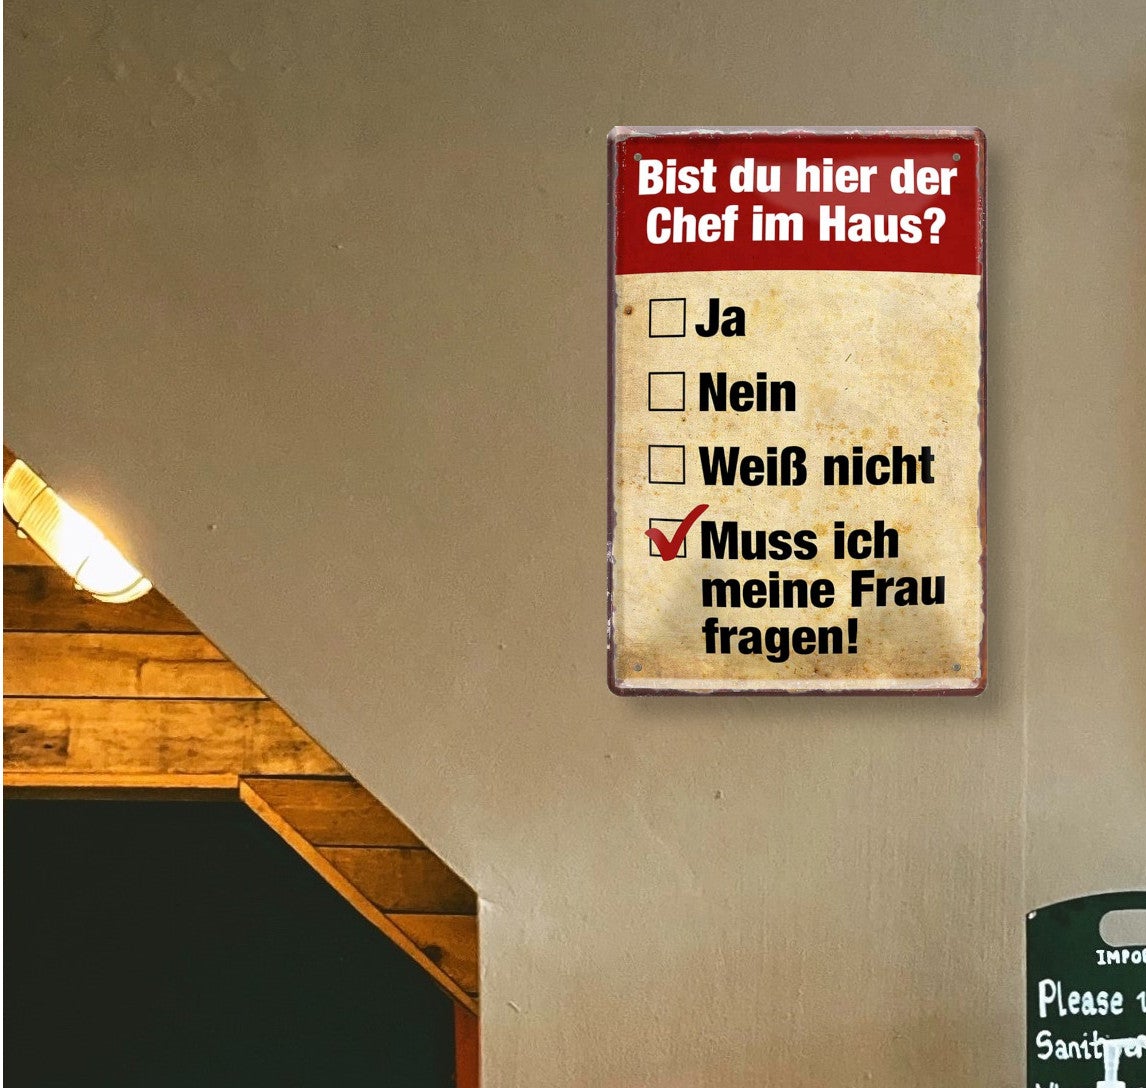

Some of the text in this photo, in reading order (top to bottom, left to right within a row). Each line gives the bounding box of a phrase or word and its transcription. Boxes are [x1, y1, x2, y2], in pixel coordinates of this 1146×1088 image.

[639, 158, 959, 197] Bist du hier der
[646, 205, 947, 246] Chef im Haus?
[695, 298, 747, 339] Ja
[699, 372, 797, 413] Nein
[699, 446, 936, 487] Weiß nicht
[702, 520, 900, 562] Muss ich
[702, 569, 946, 610] meine Frau
[702, 617, 859, 661] fragen!
[1038, 978, 1124, 1018] Please
